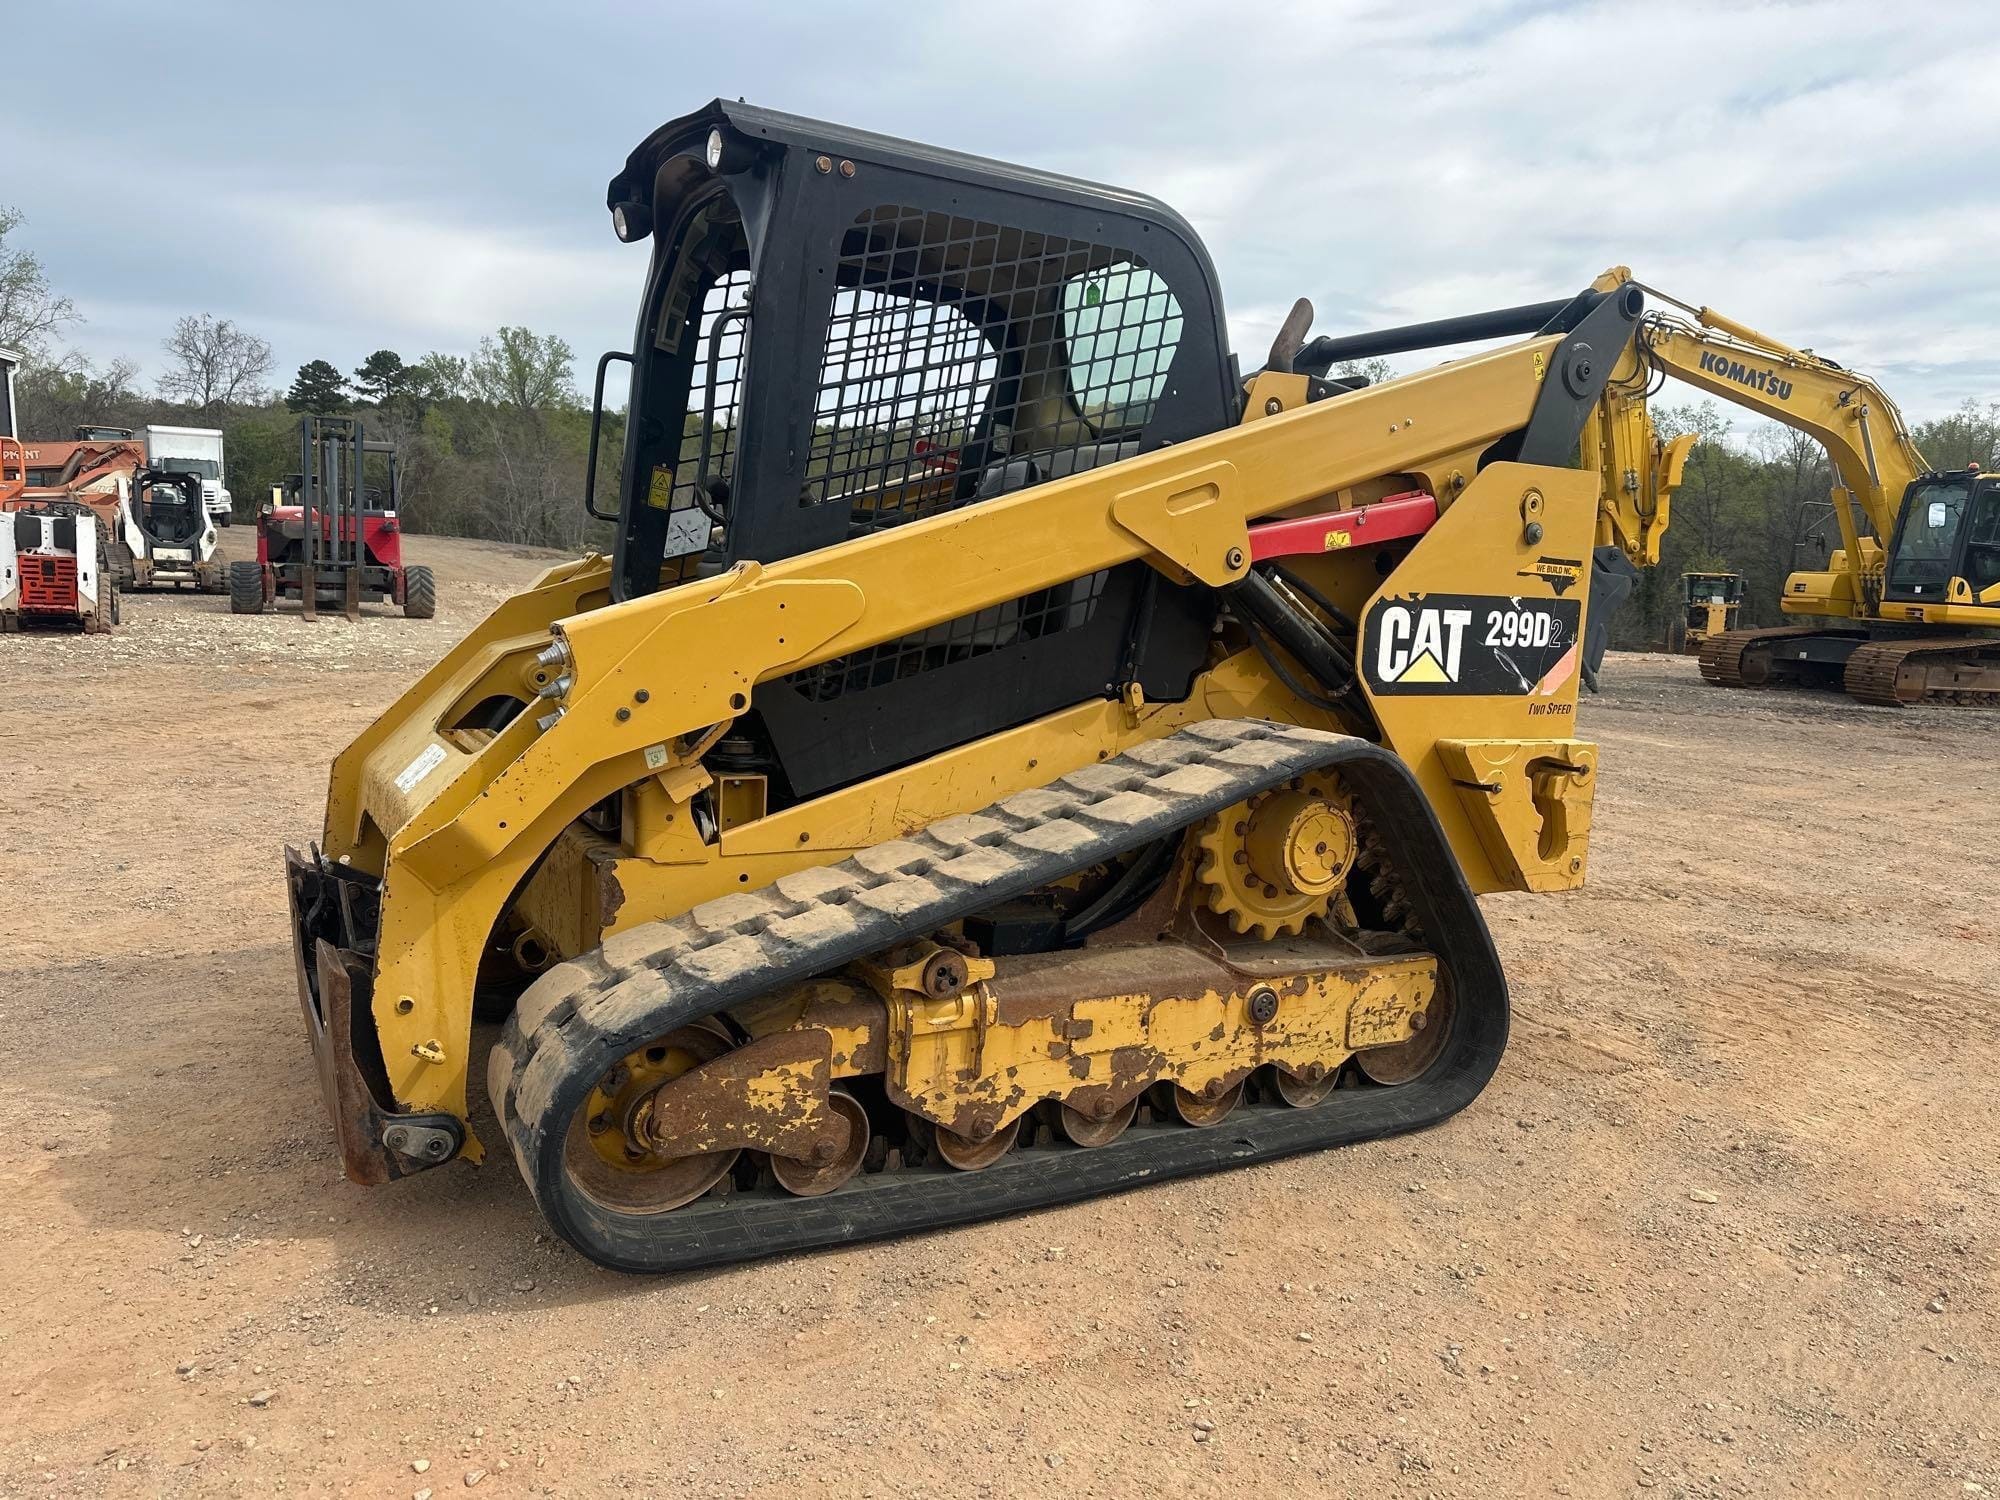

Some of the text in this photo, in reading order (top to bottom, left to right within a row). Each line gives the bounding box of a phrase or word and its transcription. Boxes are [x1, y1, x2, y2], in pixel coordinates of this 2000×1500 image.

[1699, 351, 1793, 400] KOMATSU
[3, 450, 40, 460] PMNT
[1536, 564, 1546, 573] WE
[1547, 565, 1563, 574] BUILD
[1377, 606, 1472, 682] CAT
